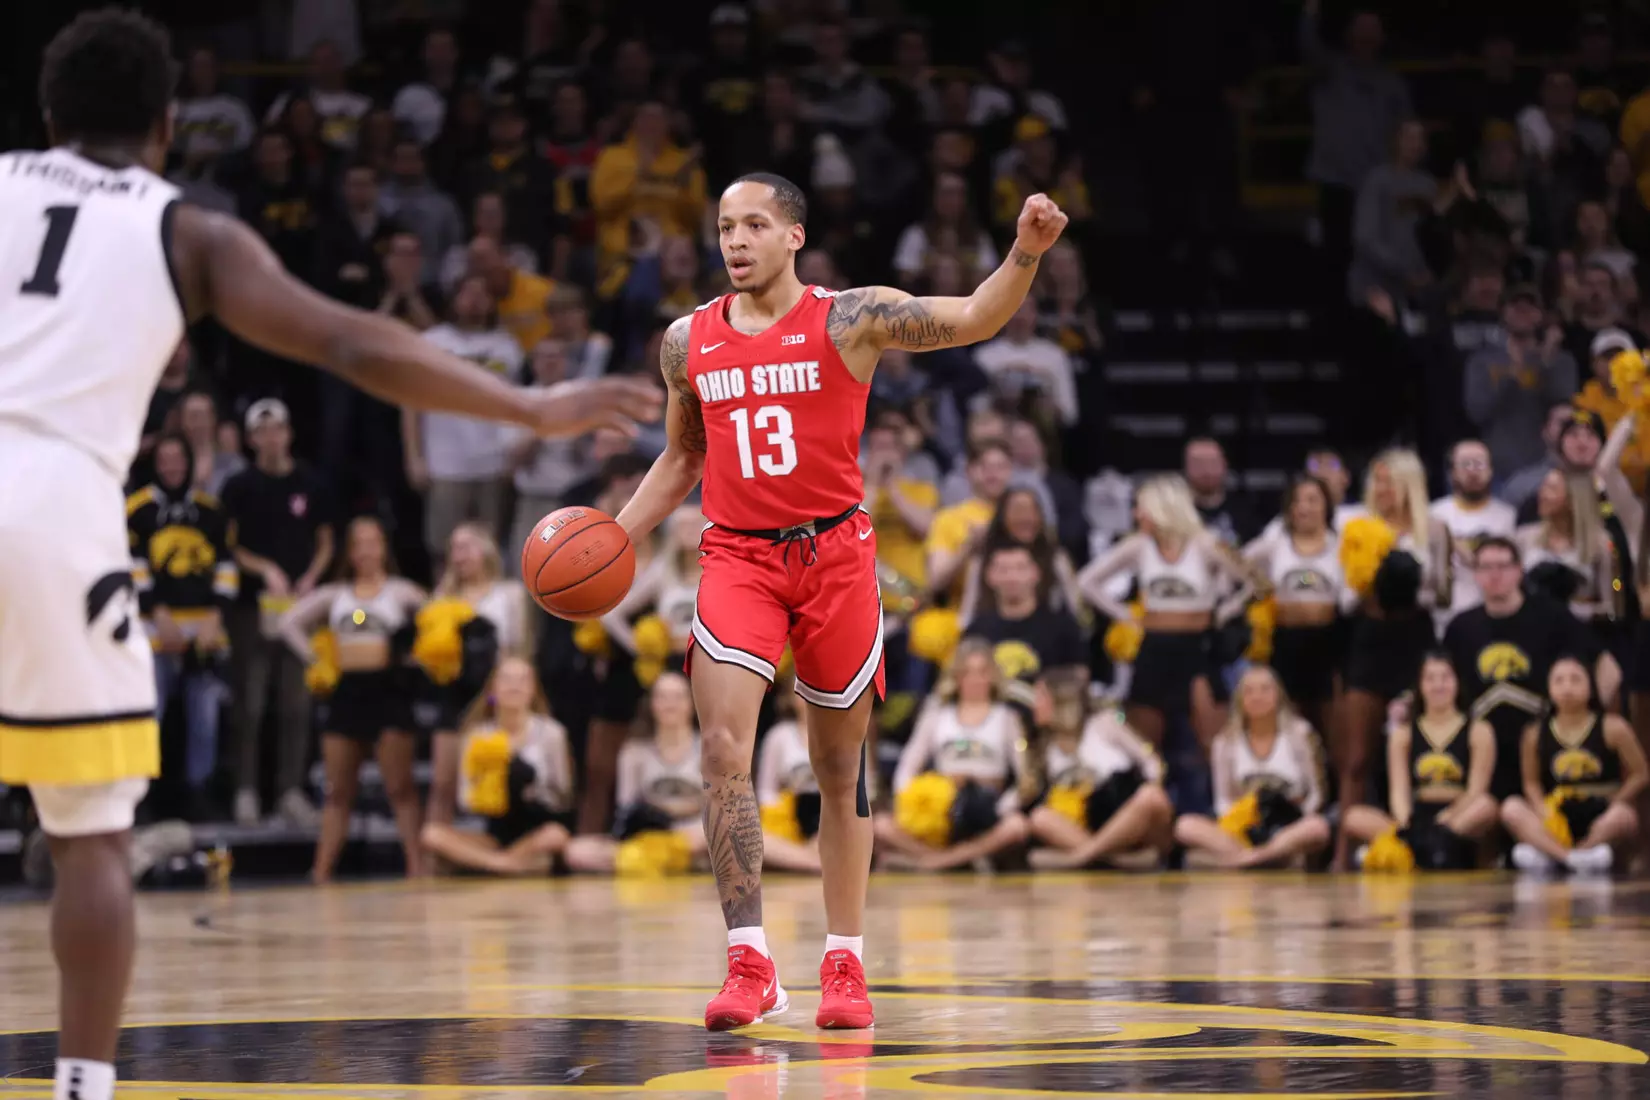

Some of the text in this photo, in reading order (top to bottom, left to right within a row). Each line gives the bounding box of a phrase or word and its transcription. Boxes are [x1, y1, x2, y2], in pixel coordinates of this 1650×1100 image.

[19, 205, 79, 298] 1
[695, 361, 822, 403] OHIO STATE
[729, 405, 798, 479] 13
